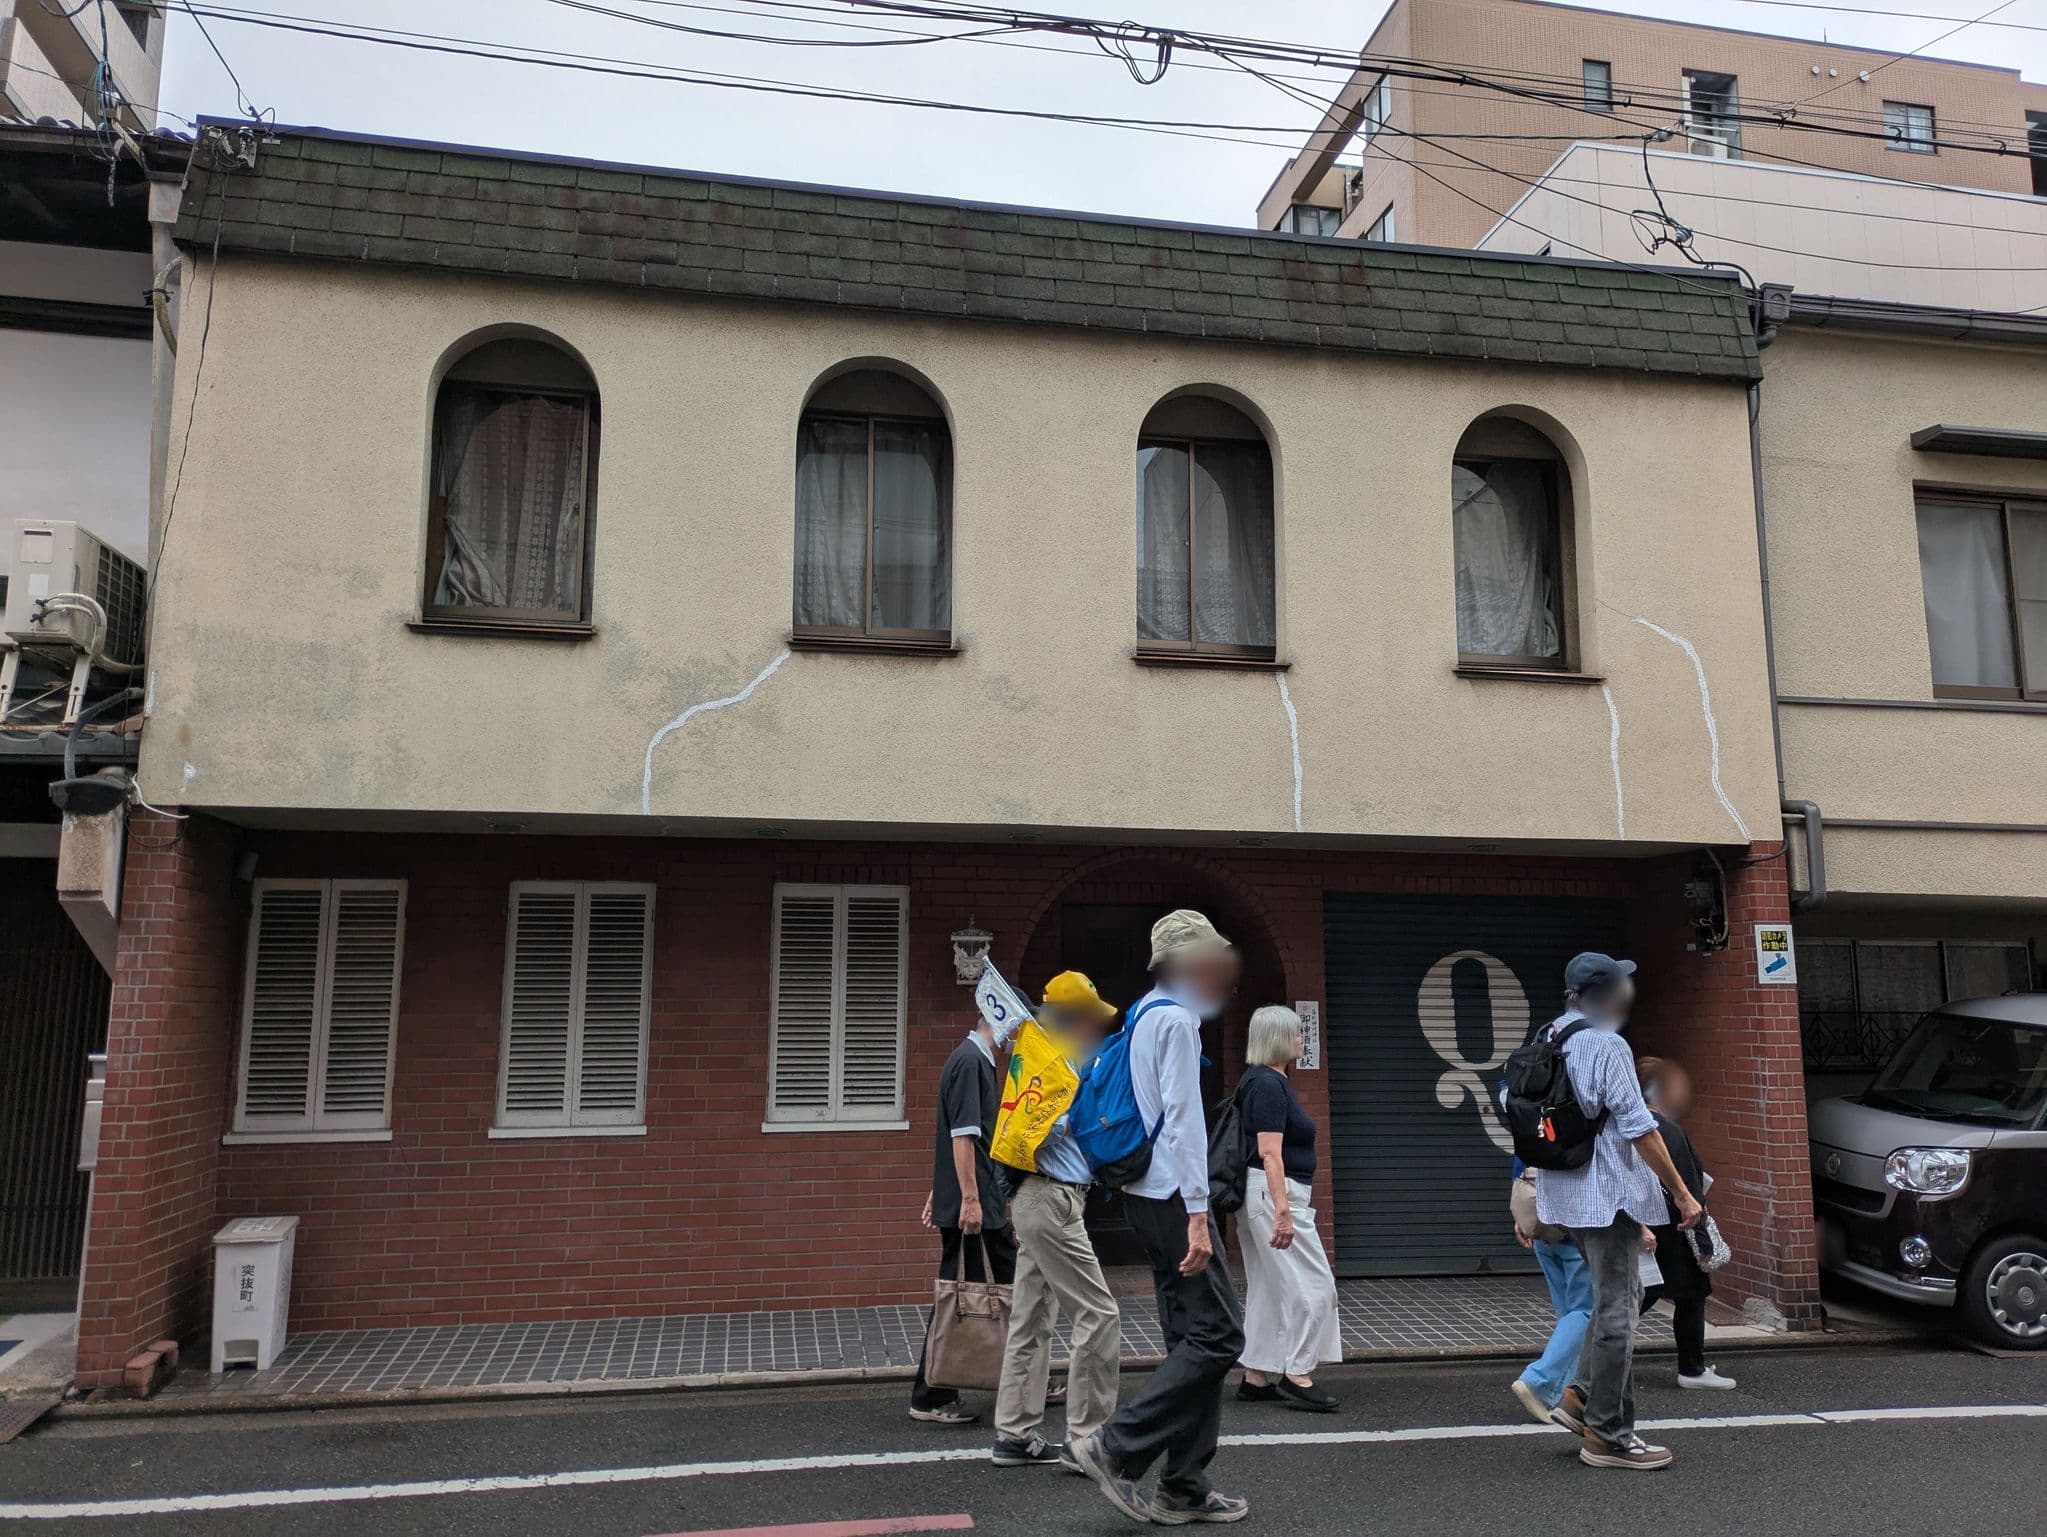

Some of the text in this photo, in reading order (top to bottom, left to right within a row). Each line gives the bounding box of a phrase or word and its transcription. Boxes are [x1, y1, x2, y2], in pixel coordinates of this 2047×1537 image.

[1763, 941, 1787, 950] 作動中
[986, 993, 1007, 1021] 3
[240, 1264, 255, 1302] 突抜町
